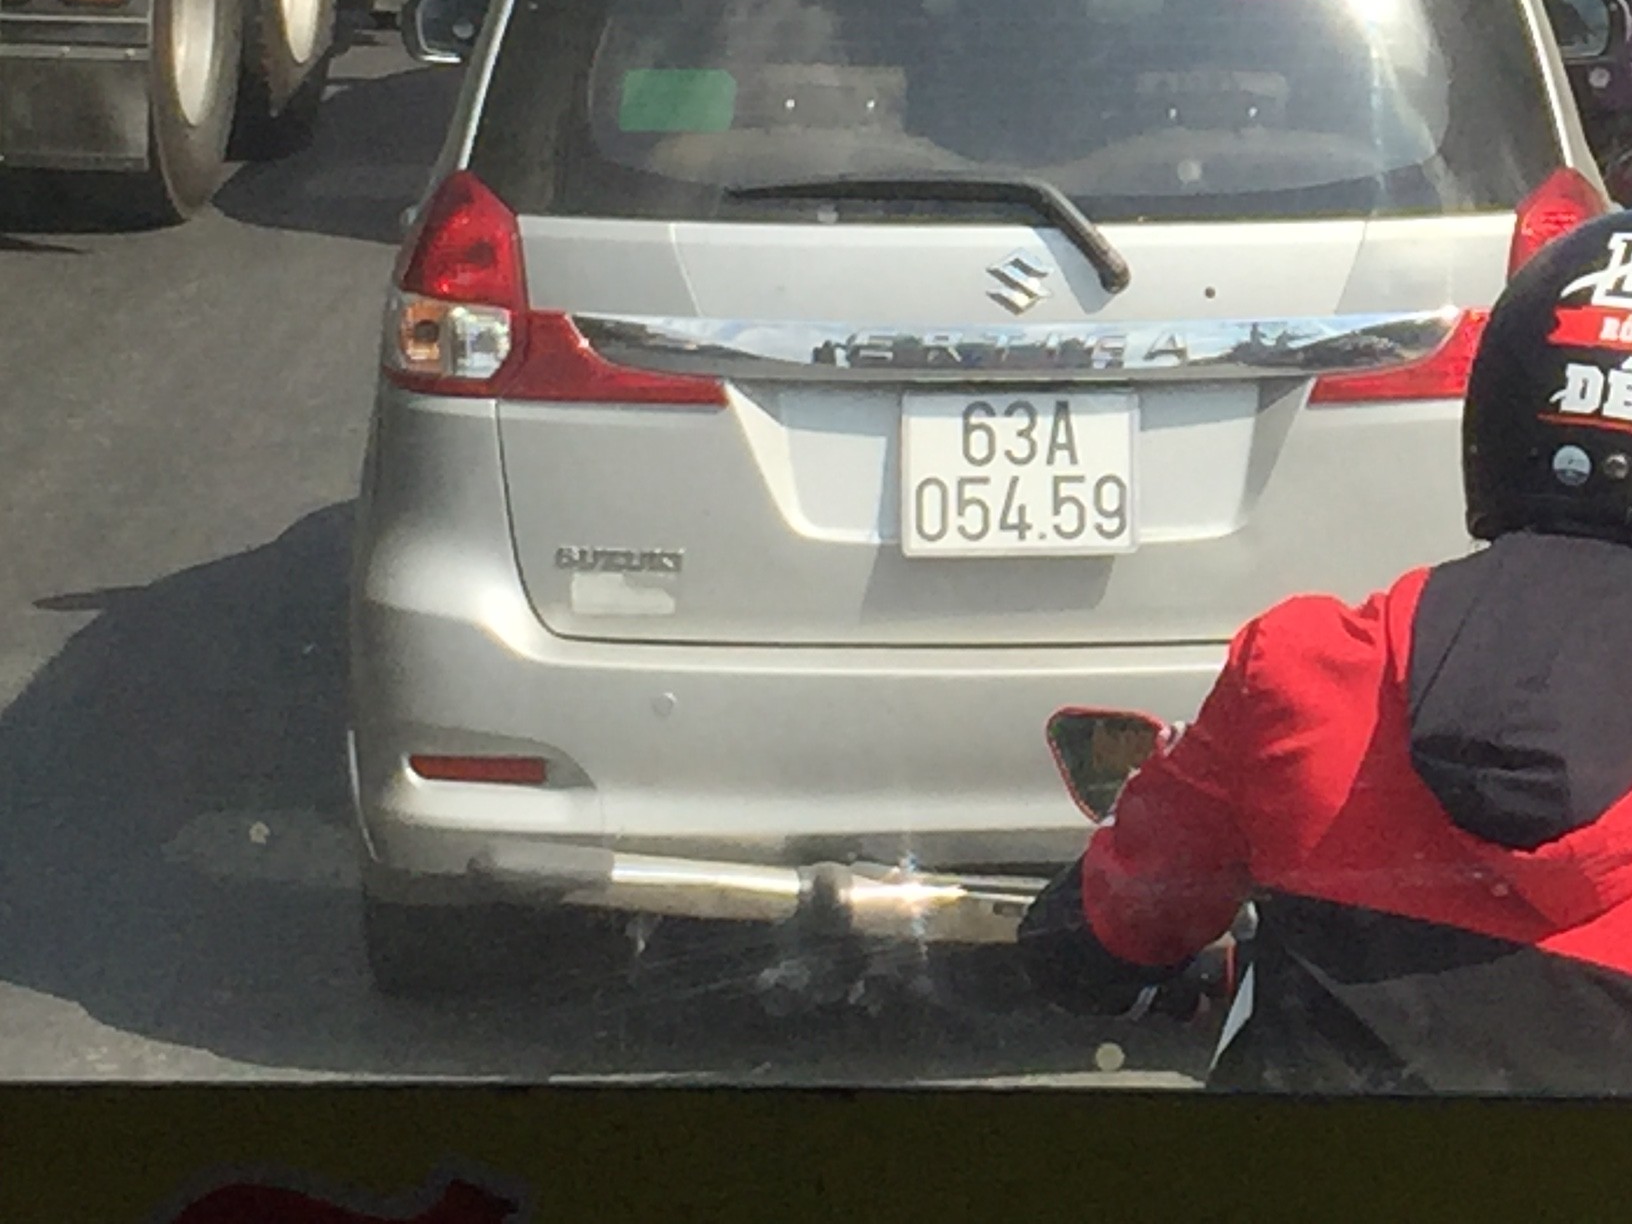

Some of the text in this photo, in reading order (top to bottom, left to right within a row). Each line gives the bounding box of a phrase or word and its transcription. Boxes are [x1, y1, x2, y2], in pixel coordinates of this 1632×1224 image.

[848, 331, 1188, 369] ERTIGA
[961, 400, 1079, 467] 63A
[914, 474, 1128, 543] 054.59
